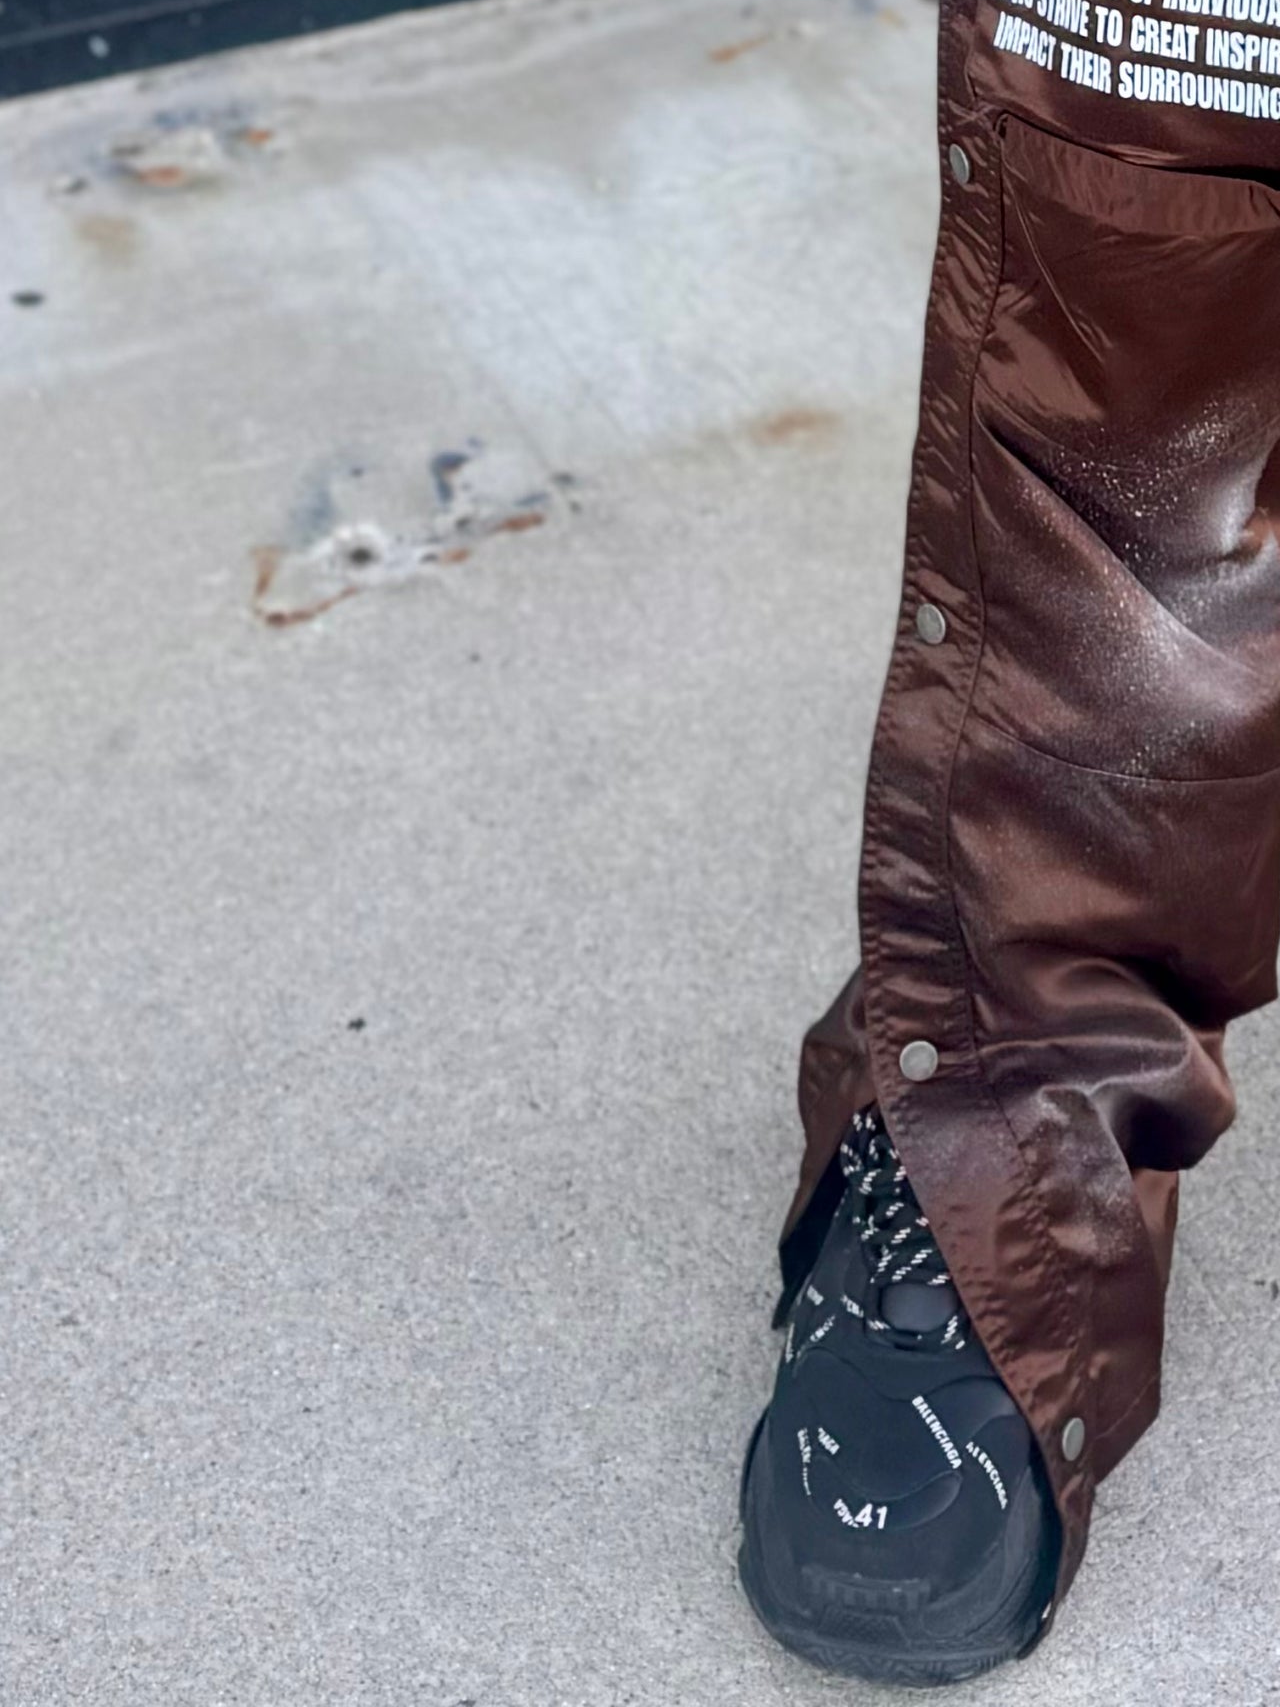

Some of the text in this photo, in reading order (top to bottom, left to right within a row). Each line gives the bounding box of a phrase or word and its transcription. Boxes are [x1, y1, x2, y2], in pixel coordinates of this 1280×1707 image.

[993, 10, 1057, 72] IMPACT
[1060, 41, 1112, 95] THEIR
[1094, 5, 1124, 48] TO
[1129, 14, 1200, 63] CREAT
[911, 1394, 963, 1470] BALENCIAGA
[853, 1502, 888, 1530] 41
